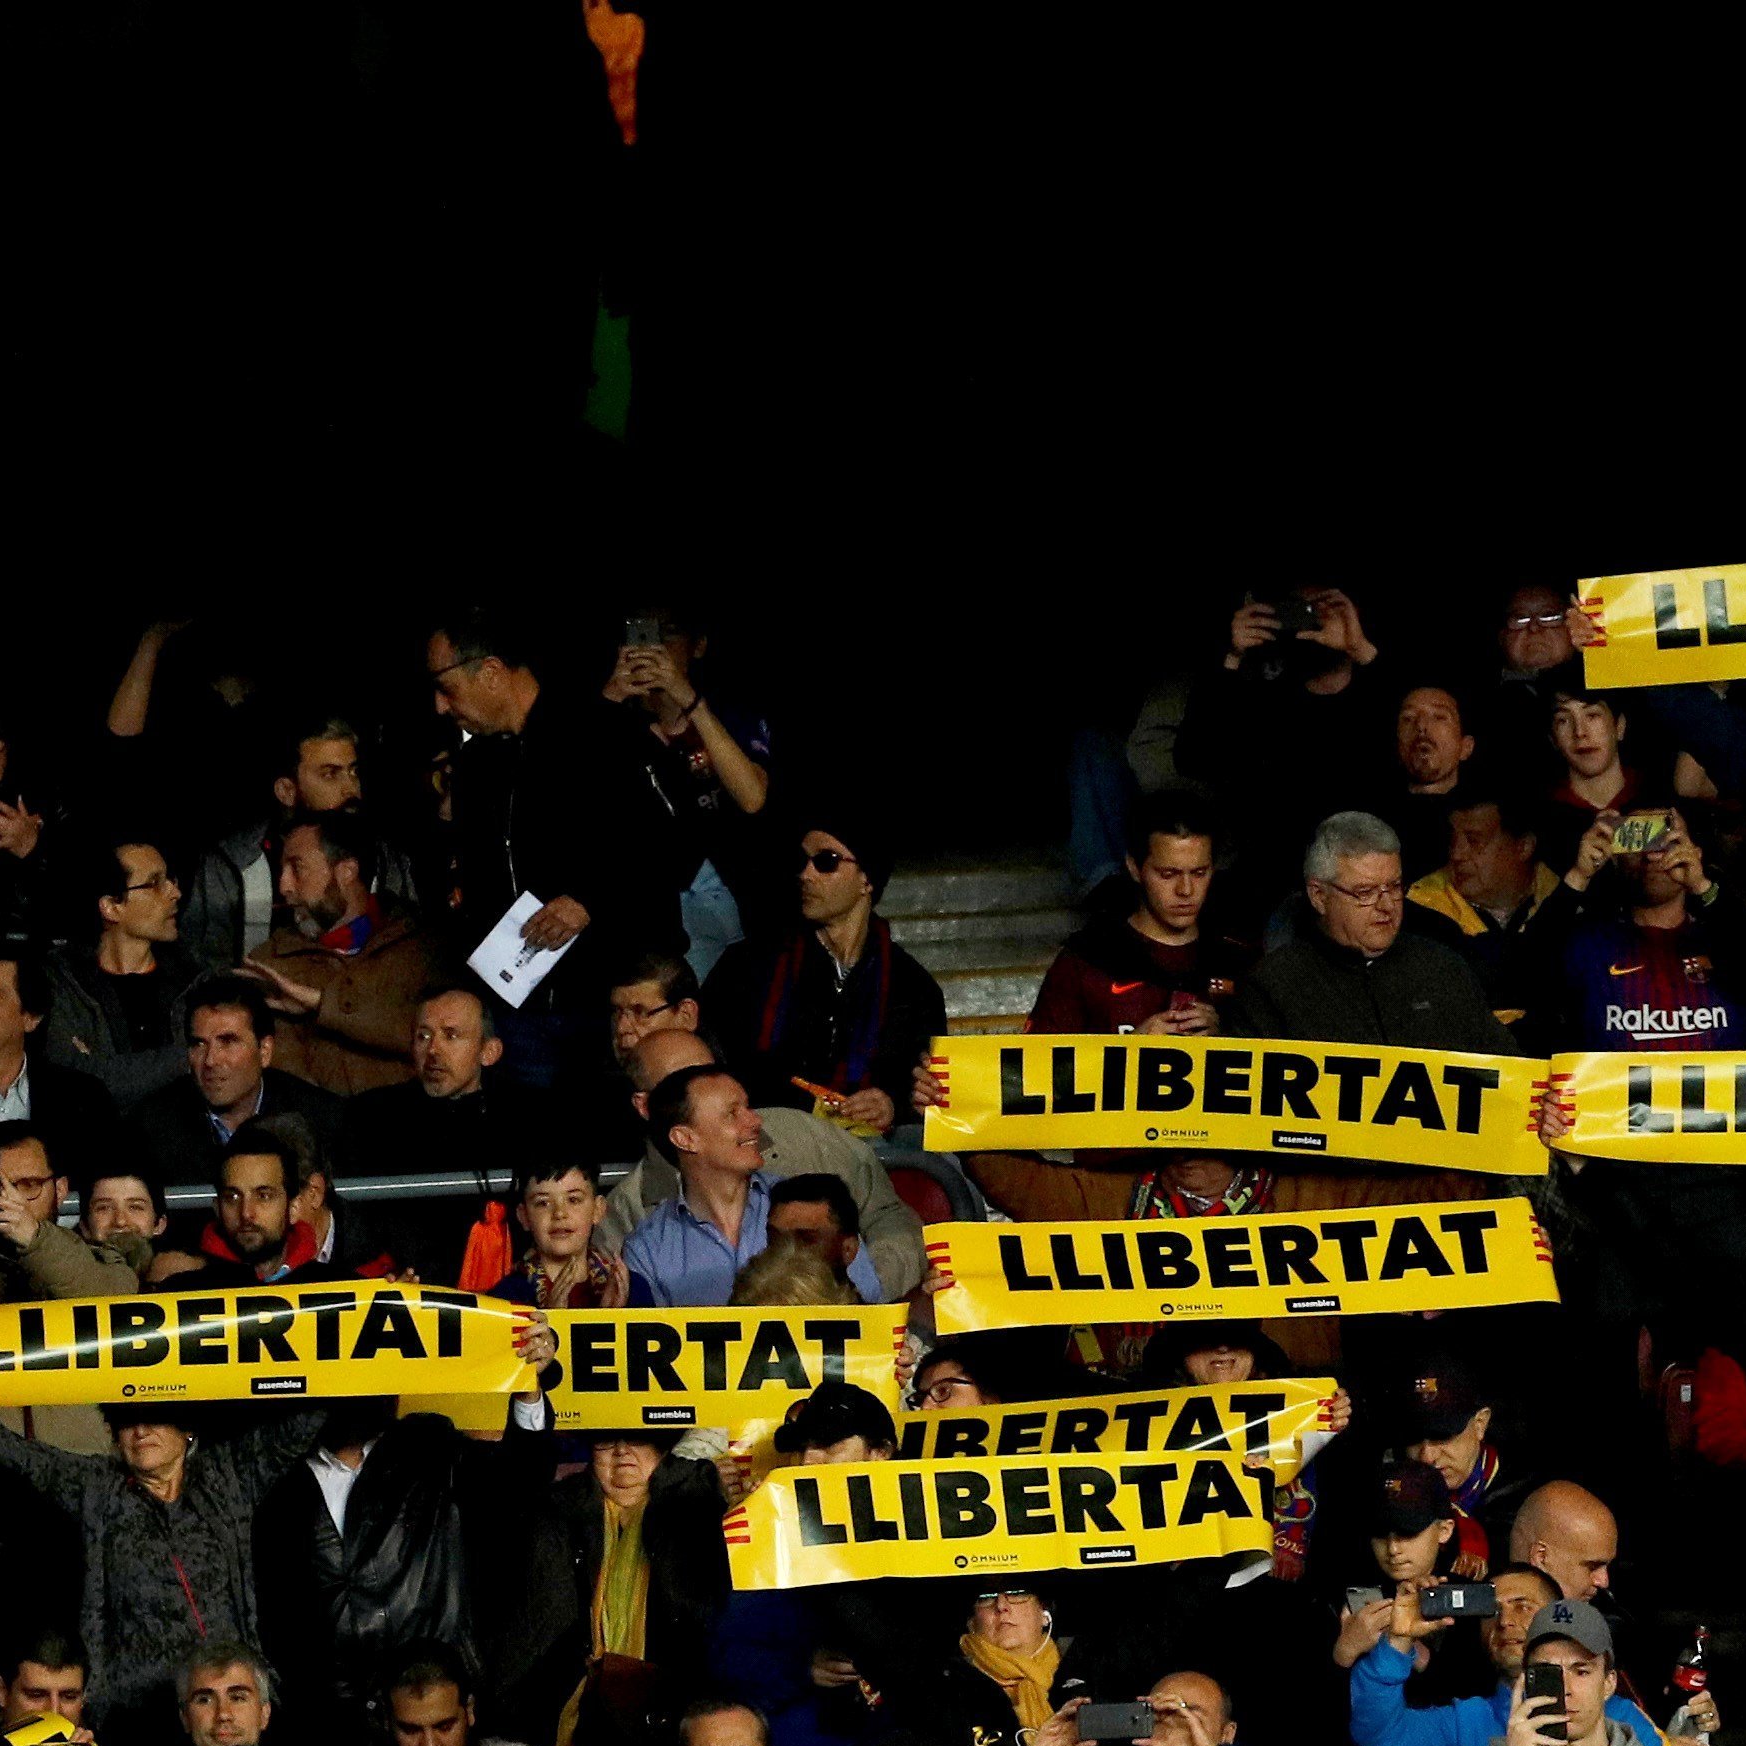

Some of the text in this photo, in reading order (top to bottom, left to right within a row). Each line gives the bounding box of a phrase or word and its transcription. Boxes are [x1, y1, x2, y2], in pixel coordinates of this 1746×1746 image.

[1606, 1003, 1728, 1031] Rakuten
[1000, 1047, 1499, 1135] LLIBERTAT
[1278, 1135, 1322, 1145] assemblea
[999, 1210, 1497, 1291] LLIBERTAT
[1292, 1299, 1335, 1309] assemblea
[257, 1380, 301, 1389] assemblea
[648, 1410, 691, 1419] assemblea
[900, 1393, 1286, 1458] IBERTAT
[1085, 1549, 1130, 1559] assemblea
[1552, 1604, 1574, 1624] LA
